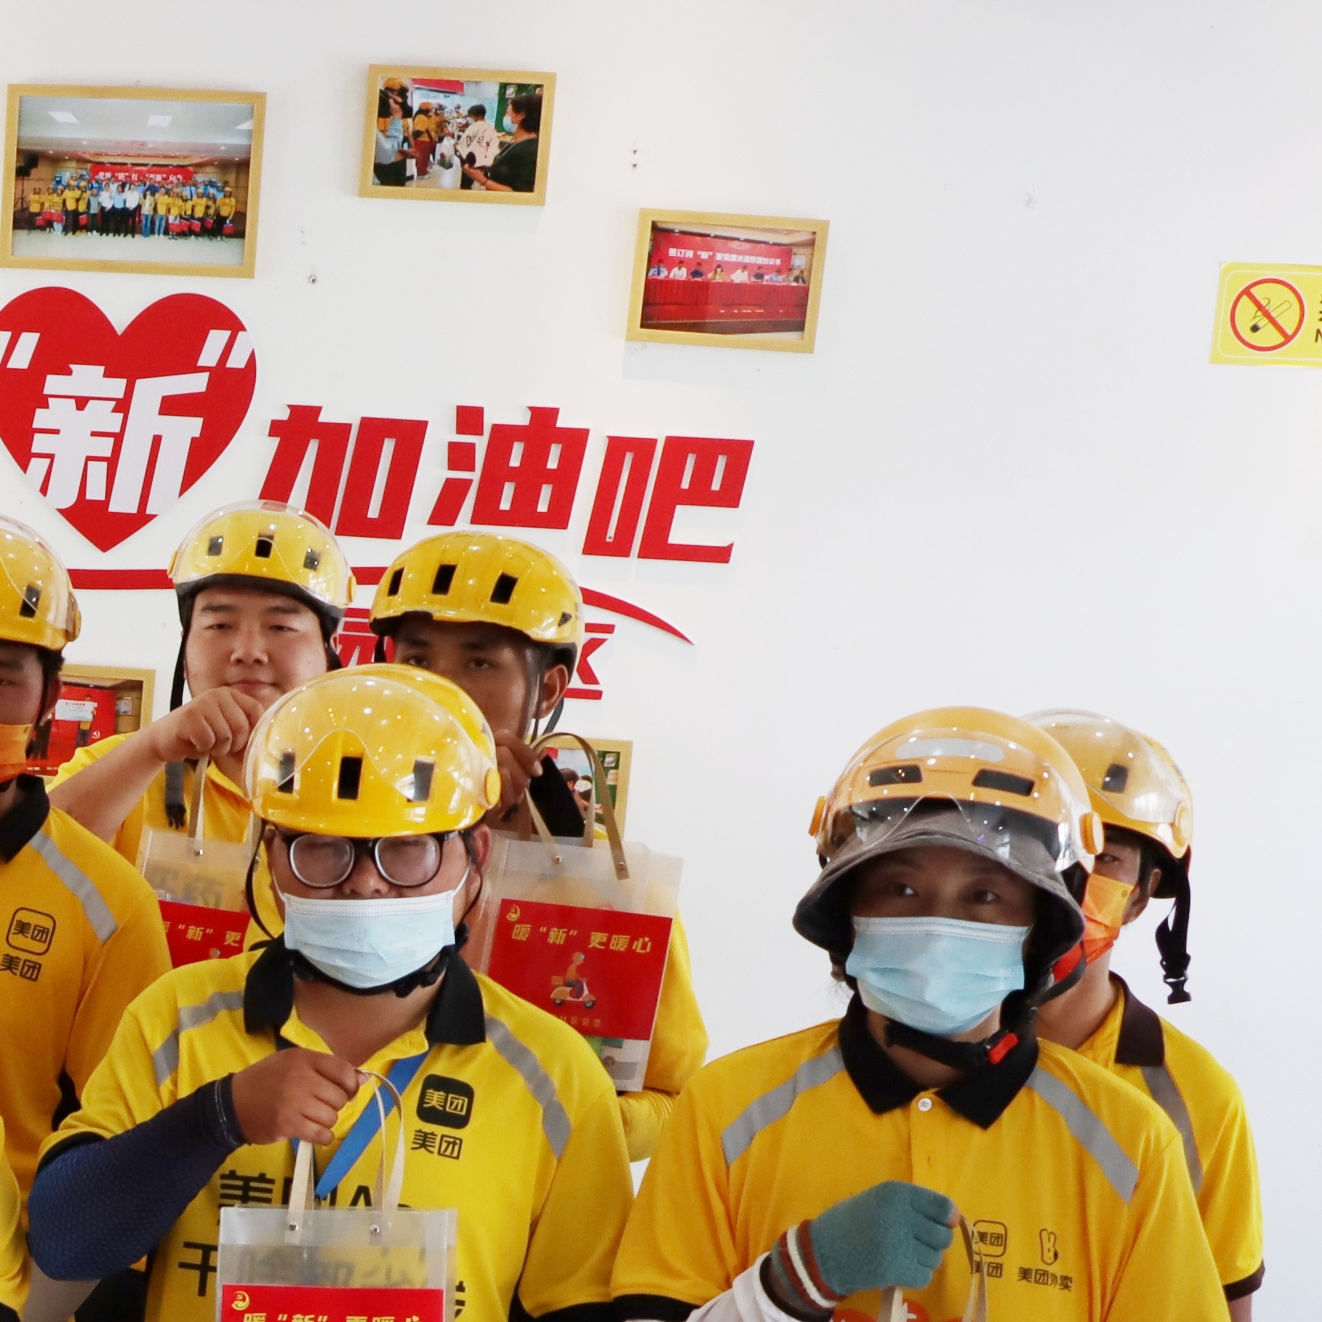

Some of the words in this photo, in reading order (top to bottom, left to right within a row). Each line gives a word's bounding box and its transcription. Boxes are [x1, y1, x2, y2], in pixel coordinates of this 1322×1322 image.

[13, 920, 50, 944] 美团
[511, 924, 651, 954] 暖“新”更暖心
[0, 954, 42, 982] 美团
[424, 1089, 468, 1116] 美团
[411, 1129, 463, 1160] 美团
[1018, 1267, 1073, 1291] 美团外卖
